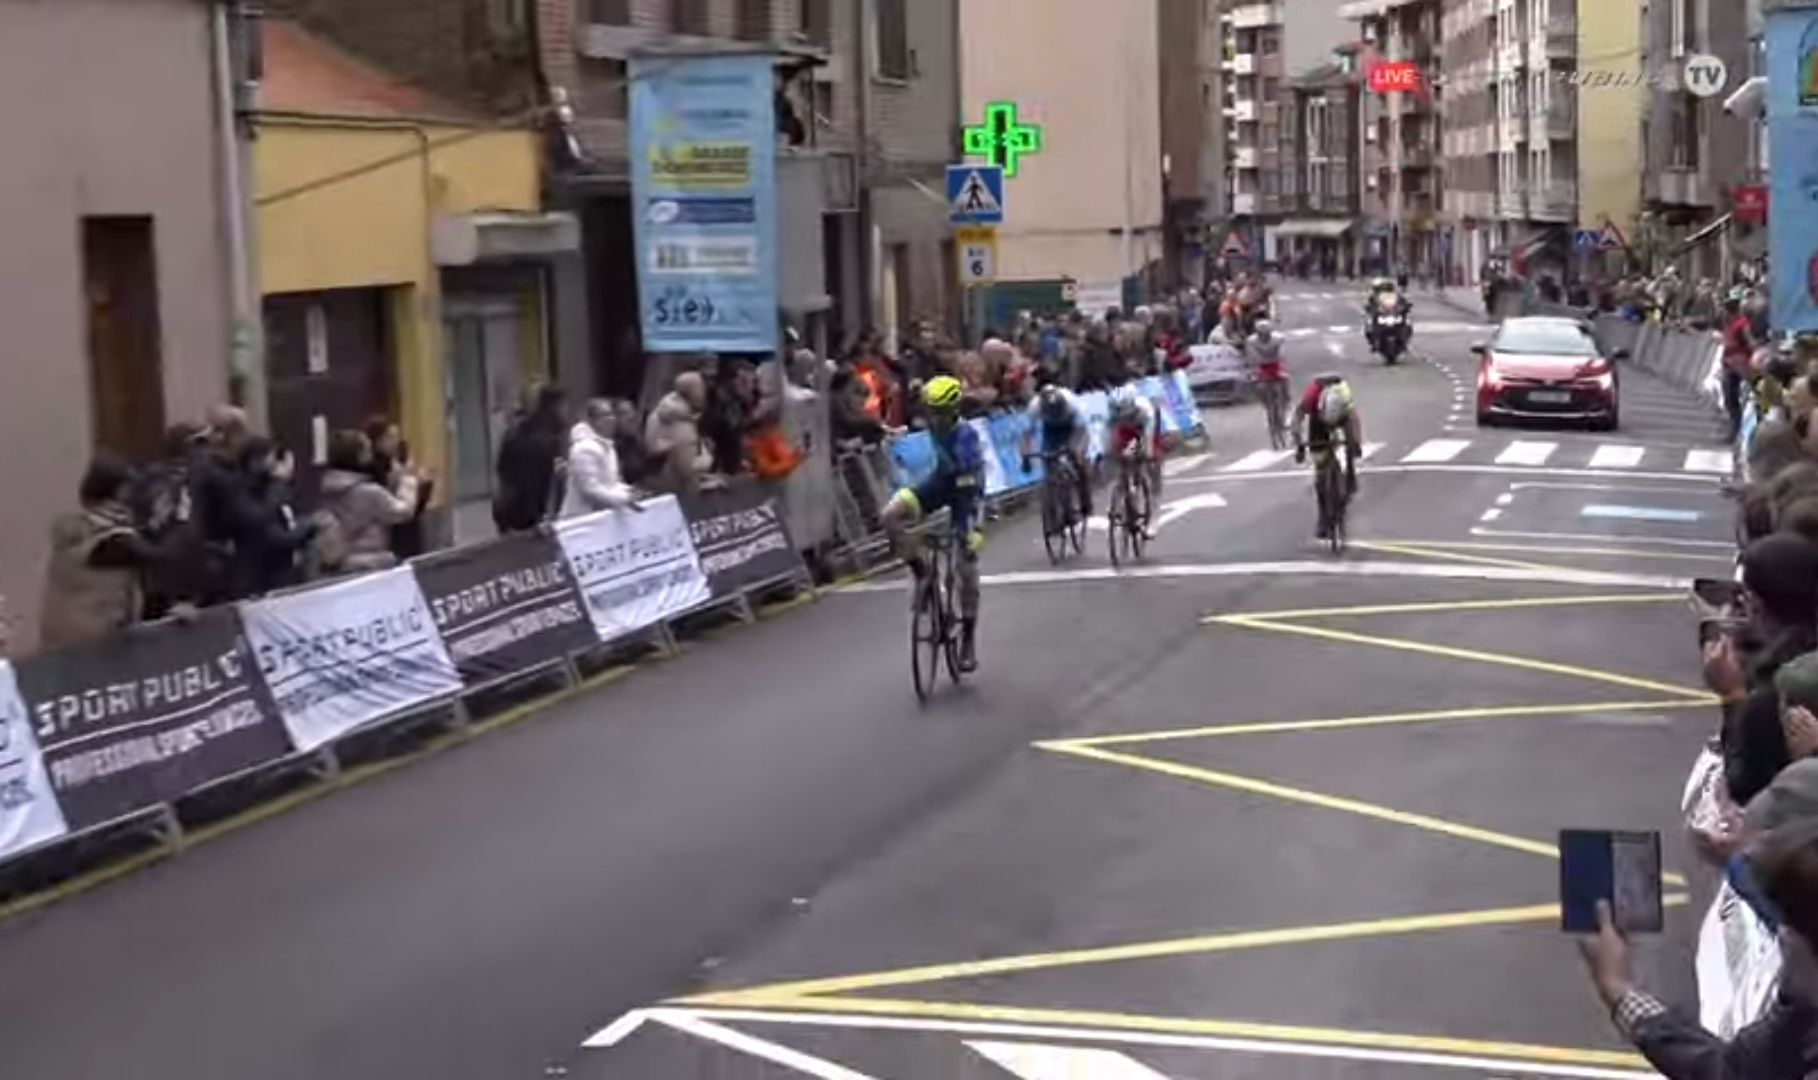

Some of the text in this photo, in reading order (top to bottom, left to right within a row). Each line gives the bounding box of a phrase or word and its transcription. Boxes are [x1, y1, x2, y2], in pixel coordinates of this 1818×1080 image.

[971, 260, 983, 277] 6
[572, 543, 625, 577] SPORT
[432, 580, 498, 625] SPORT
[499, 561, 566, 600] PUBLIC
[260, 629, 342, 674] SPORT
[343, 607, 423, 648] PUBLIC
[35, 681, 138, 737] SPORT
[142, 648, 242, 708] PUBLC
